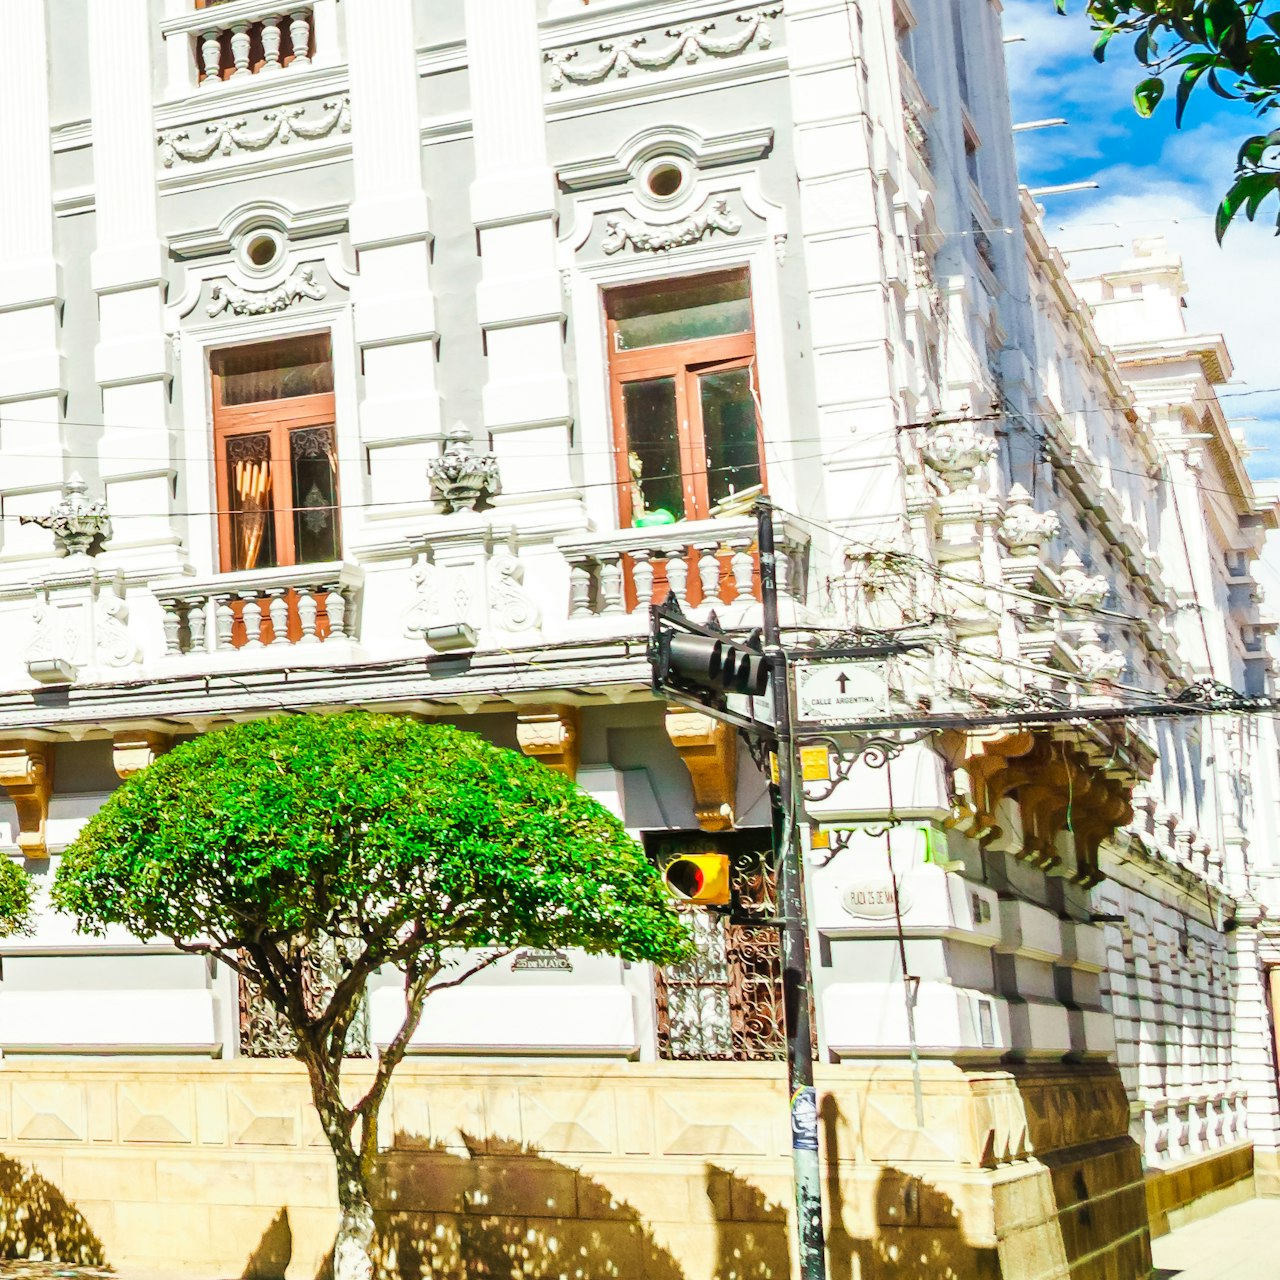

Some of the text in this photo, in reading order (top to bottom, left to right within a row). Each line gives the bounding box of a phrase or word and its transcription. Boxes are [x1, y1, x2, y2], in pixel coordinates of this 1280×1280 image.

[811, 696, 875, 706] CALLE ARGENTINA
[850, 891, 866, 905] PLAZA
[537, 958, 567, 967] MAYO
